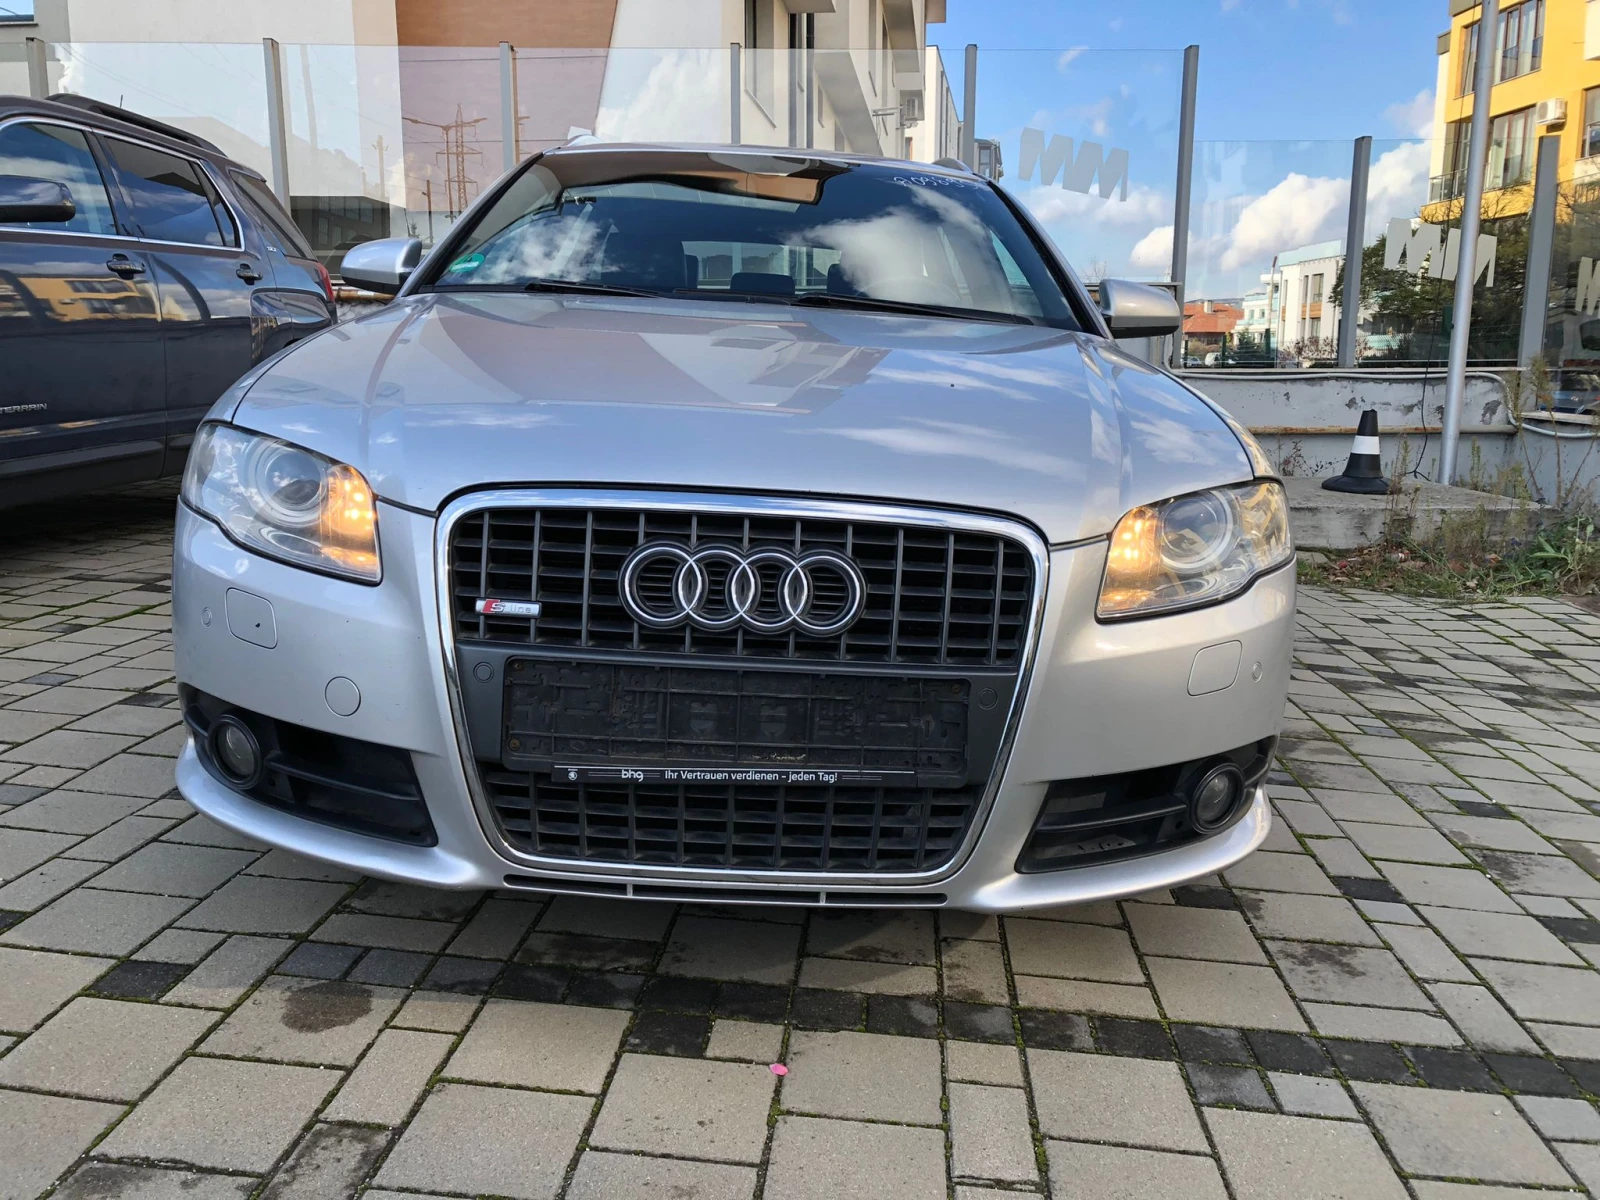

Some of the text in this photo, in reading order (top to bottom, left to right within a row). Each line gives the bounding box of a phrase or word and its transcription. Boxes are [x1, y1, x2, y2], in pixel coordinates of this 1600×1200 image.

[511, 604, 532, 614] line
[621, 769, 644, 782] bhg
[665, 770, 678, 779] Ihr
[680, 771, 728, 780] Vertrauen
[731, 771, 779, 780] verdienen
[787, 771, 816, 782] jeden
[818, 772, 838, 783] Tag!
